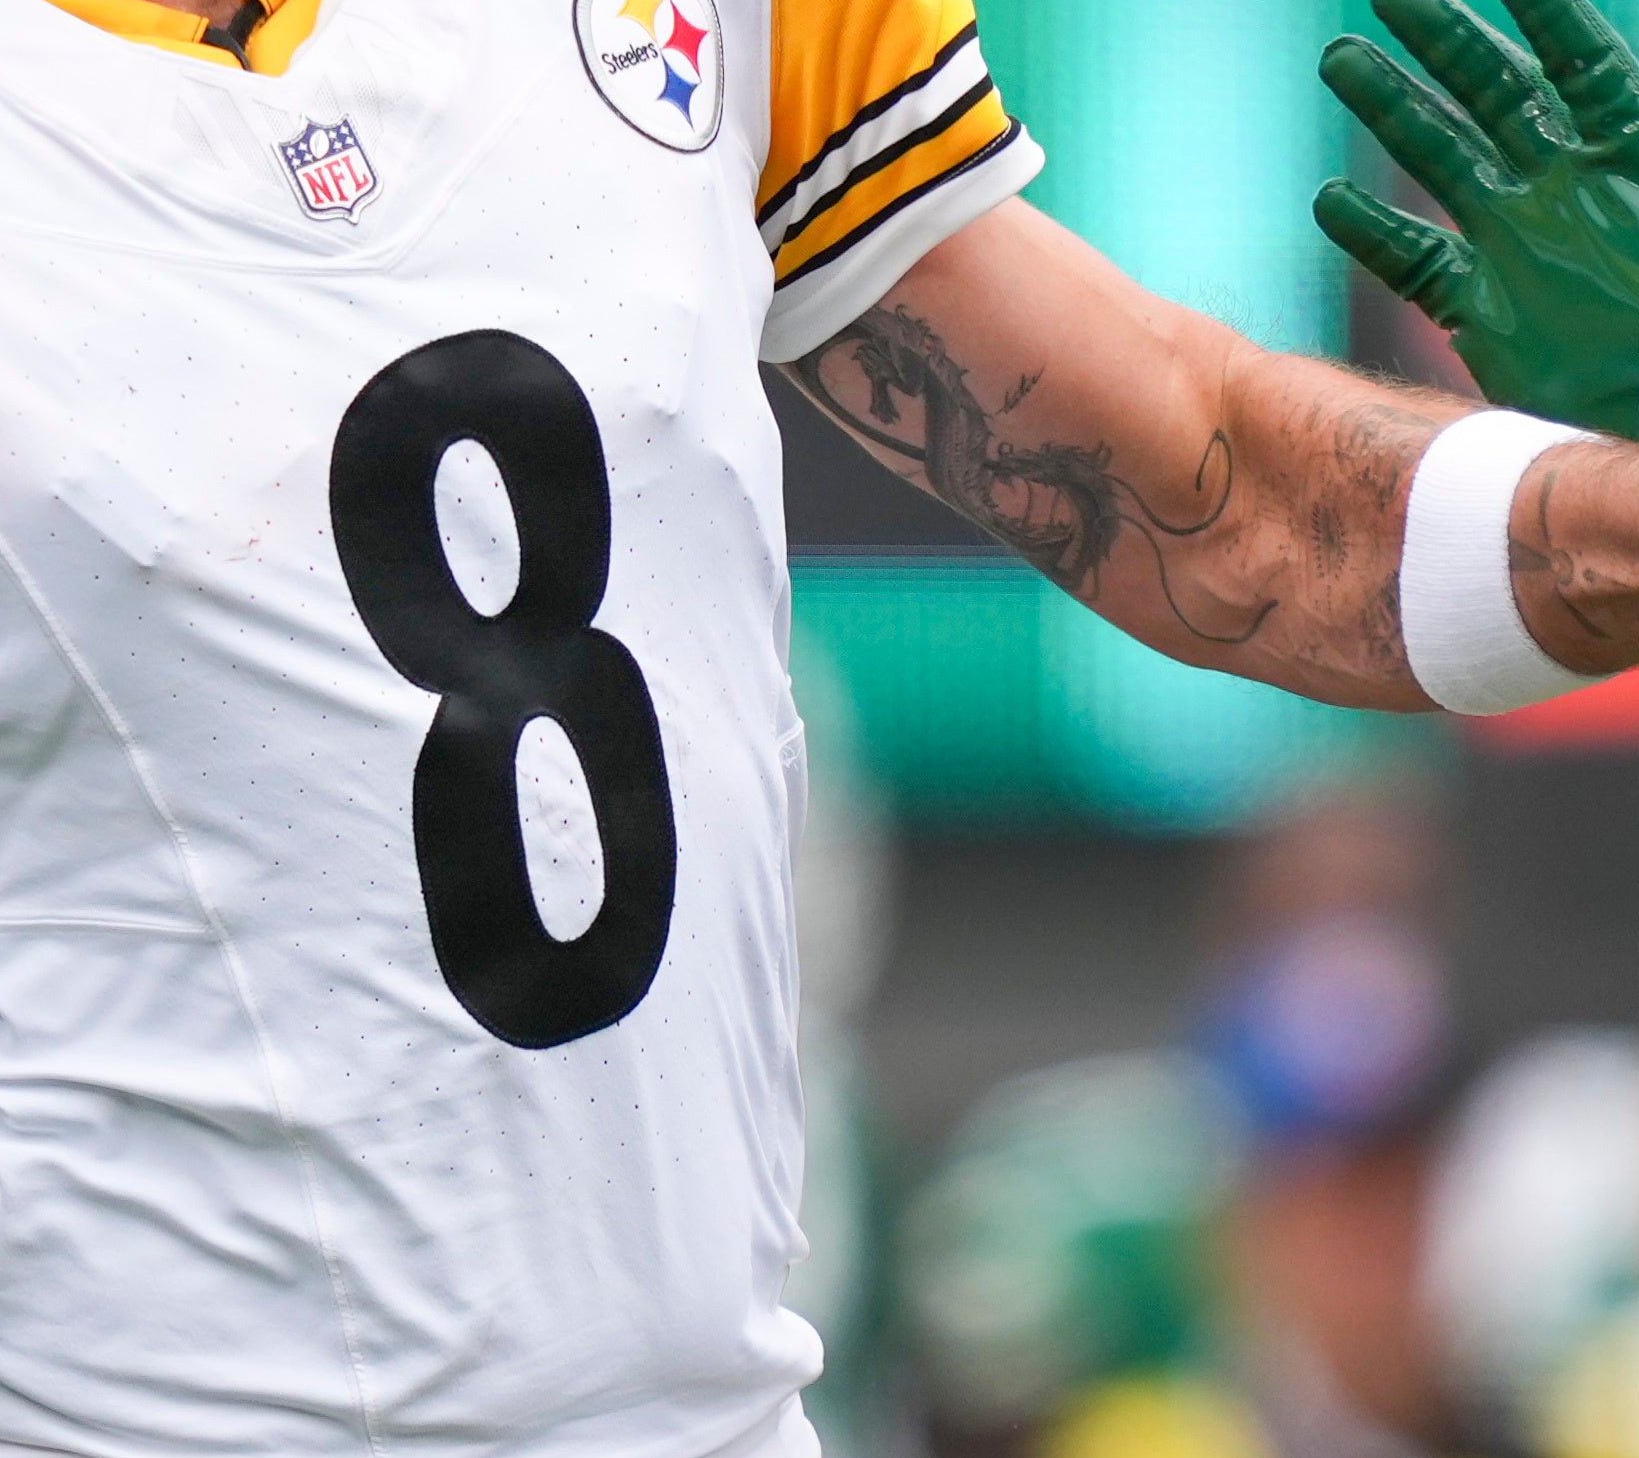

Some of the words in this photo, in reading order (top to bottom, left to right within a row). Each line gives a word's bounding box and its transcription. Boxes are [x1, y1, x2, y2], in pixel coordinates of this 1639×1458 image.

[601, 42, 659, 75] Steelers
[302, 155, 370, 205] NFL
[328, 328, 677, 1050] 8
